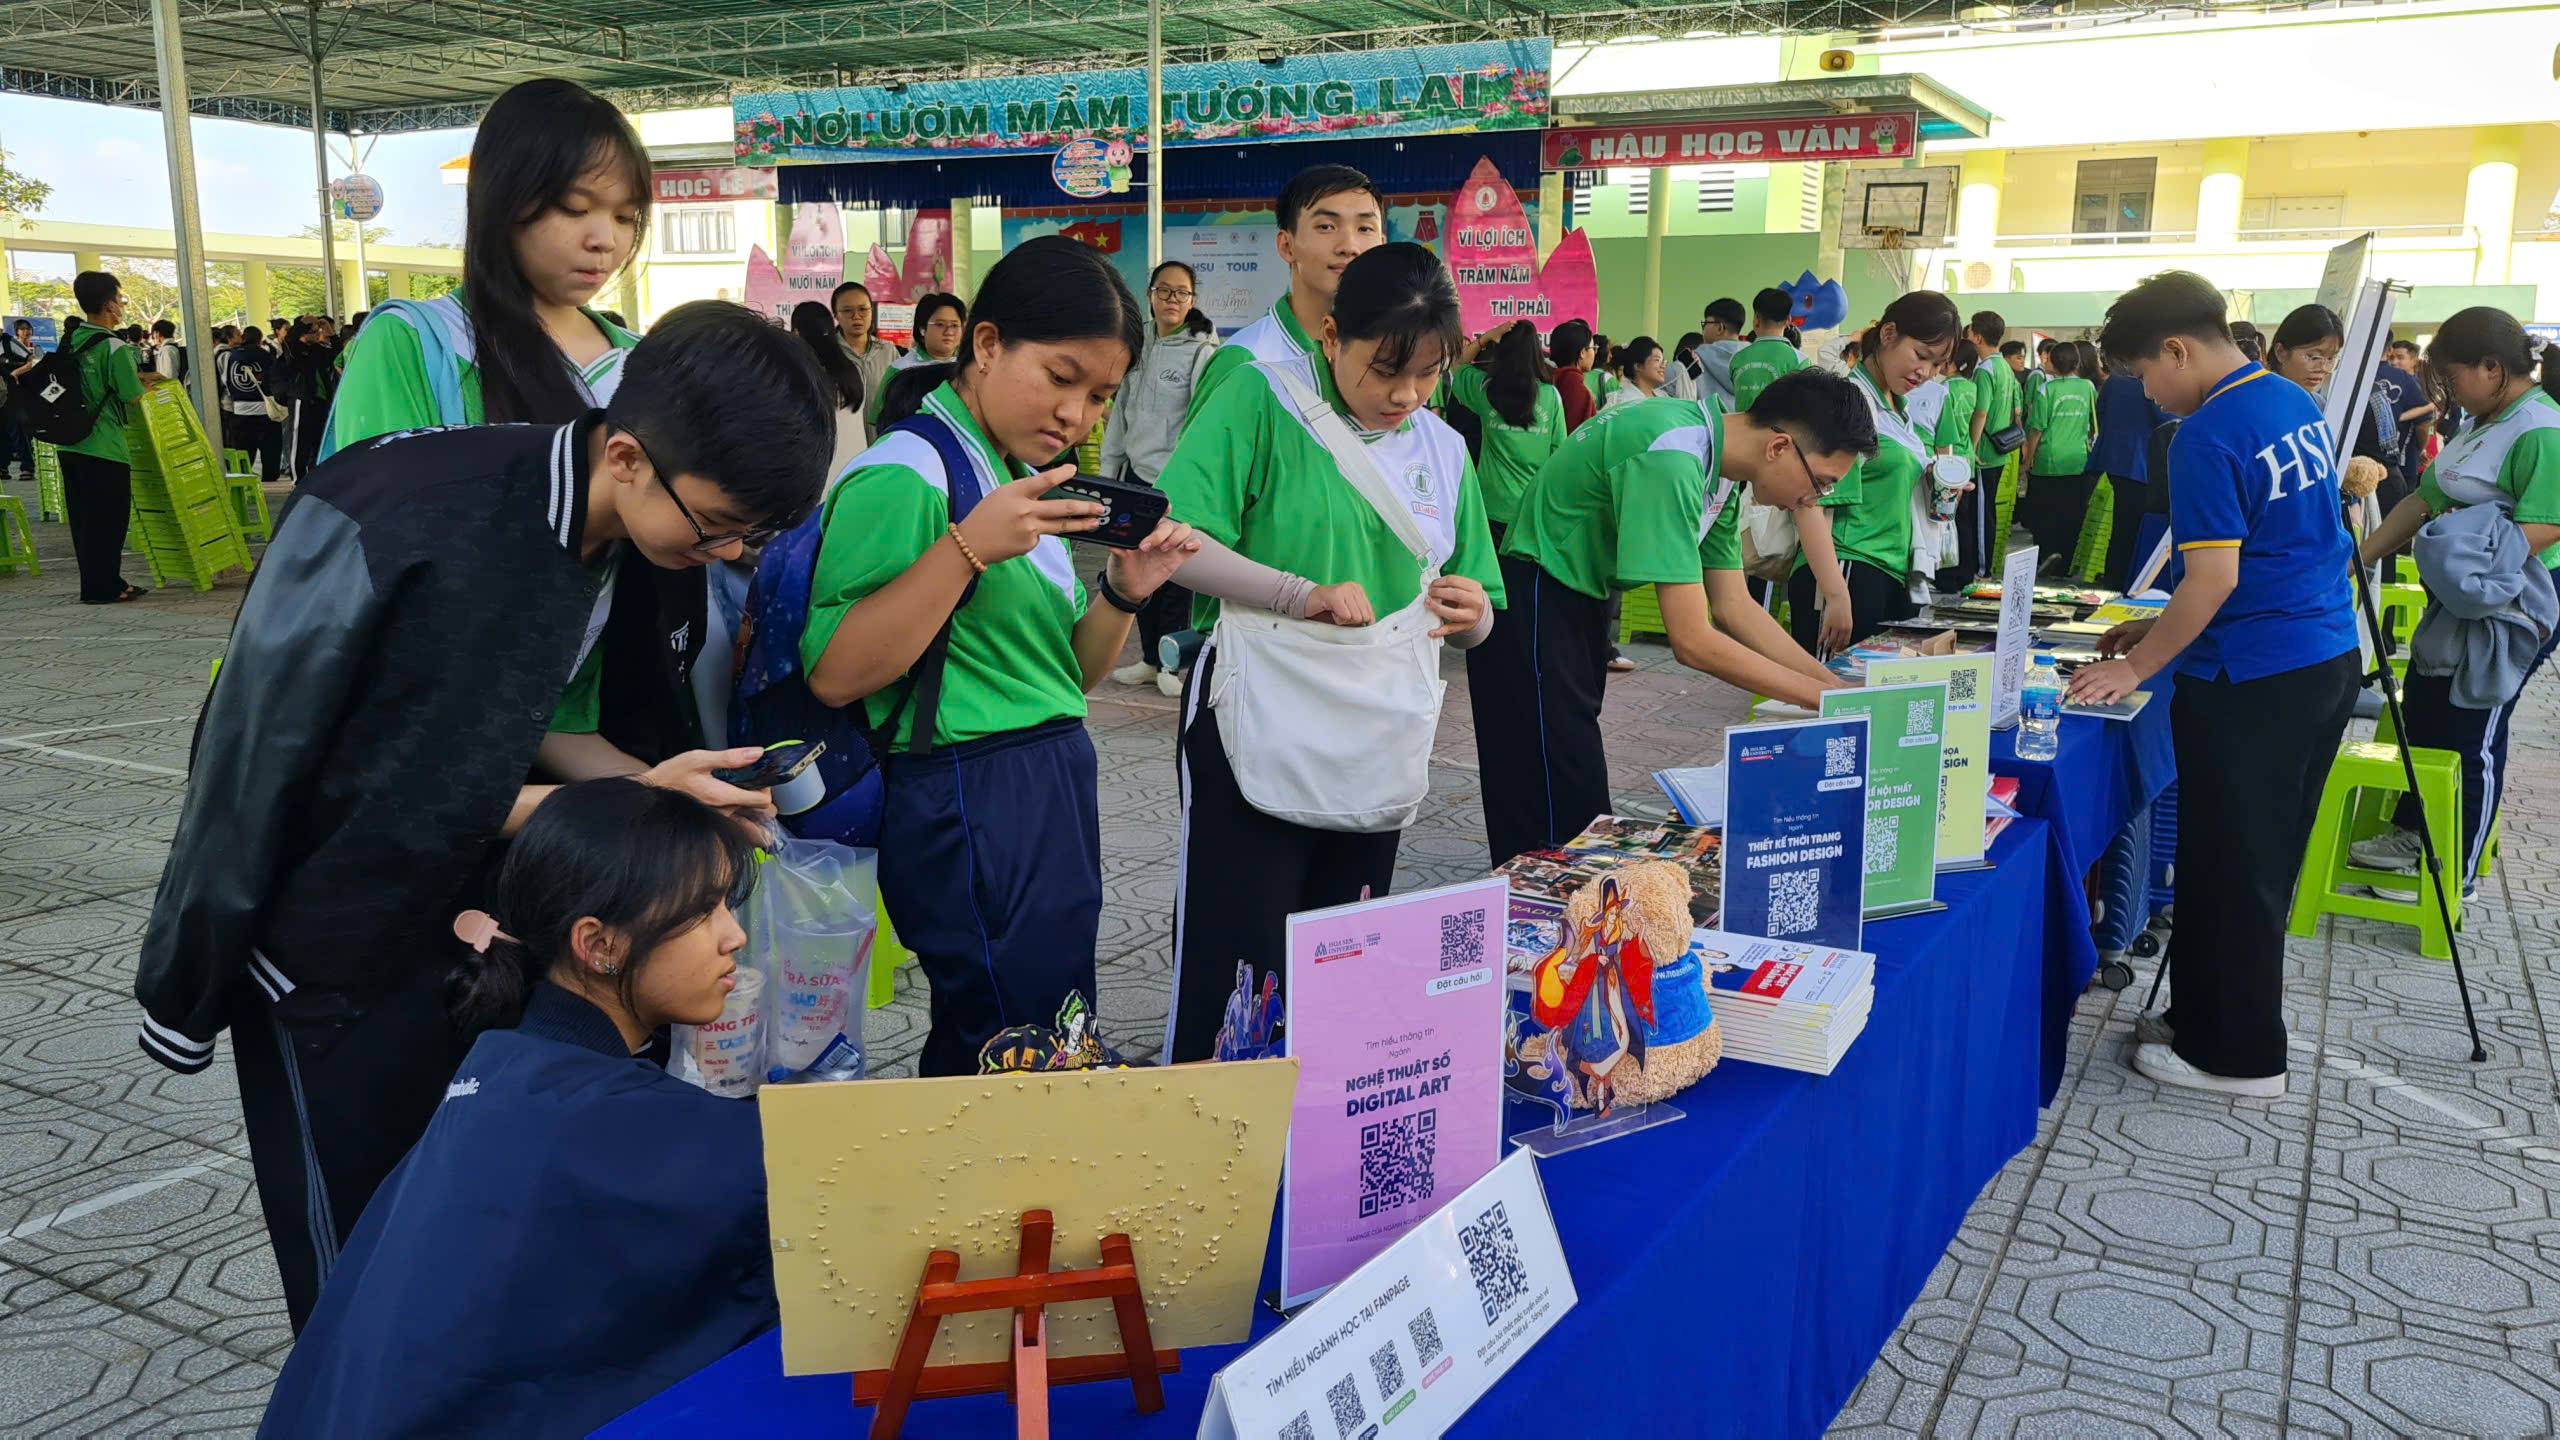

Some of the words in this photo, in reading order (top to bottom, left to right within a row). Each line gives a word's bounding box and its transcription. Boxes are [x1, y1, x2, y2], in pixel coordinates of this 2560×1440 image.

[783, 106, 863, 145] NƠI
[880, 101, 989, 141] ƯƠM
[1006, 84, 1131, 135] MẦM
[1161, 80, 1355, 126] TƯƠNG
[1378, 72, 1479, 113] LAI
[1590, 133, 1667, 164] HẬU
[1681, 131, 1764, 160] HỌC
[1777, 124, 1861, 153] VĂN
[661, 178, 712, 200] HỌC
[1459, 226, 1472, 246] VÌ
[1475, 227, 1497, 250] LỢI
[1502, 225, 1526, 246] ÍCH
[1226, 262, 1258, 272] TOUR
[1459, 264, 1496, 284] TRĂM
[1500, 264, 1530, 284] NĂM
[1490, 296, 1514, 316] THÌ
[1517, 294, 1550, 316] PHẢI
[1883, 795, 1920, 810] DESIGN
[1748, 837, 1773, 852] THIẾT
[1775, 835, 1787, 849] KẾ
[1787, 834, 1809, 847] THỜI
[1810, 832, 1841, 845] TRANG
[1746, 851, 1798, 869] FASHION
[1800, 845, 1843, 862] DESIGN
[1436, 980, 1452, 990] Đặt
[1453, 976, 1468, 986] câu
[1399, 1031, 1423, 1043] thông
[1424, 1027, 1435, 1036] tin
[1346, 1068, 1385, 1092] NGHỆ
[1387, 1059, 1430, 1082] THUẬT
[1432, 1049, 1451, 1071] SỐ
[1346, 1085, 1415, 1117] DIGITAL
[1418, 1075, 1452, 1098] ART
[1265, 1377, 1285, 1398] TÌM
[1284, 1356, 1306, 1385] HIỂU
[1306, 1333, 1340, 1366] NGÀNH
[1339, 1315, 1361, 1340] HỌC
[1359, 1302, 1374, 1322] TẠI
[1374, 1275, 1411, 1313] FANPAGE
